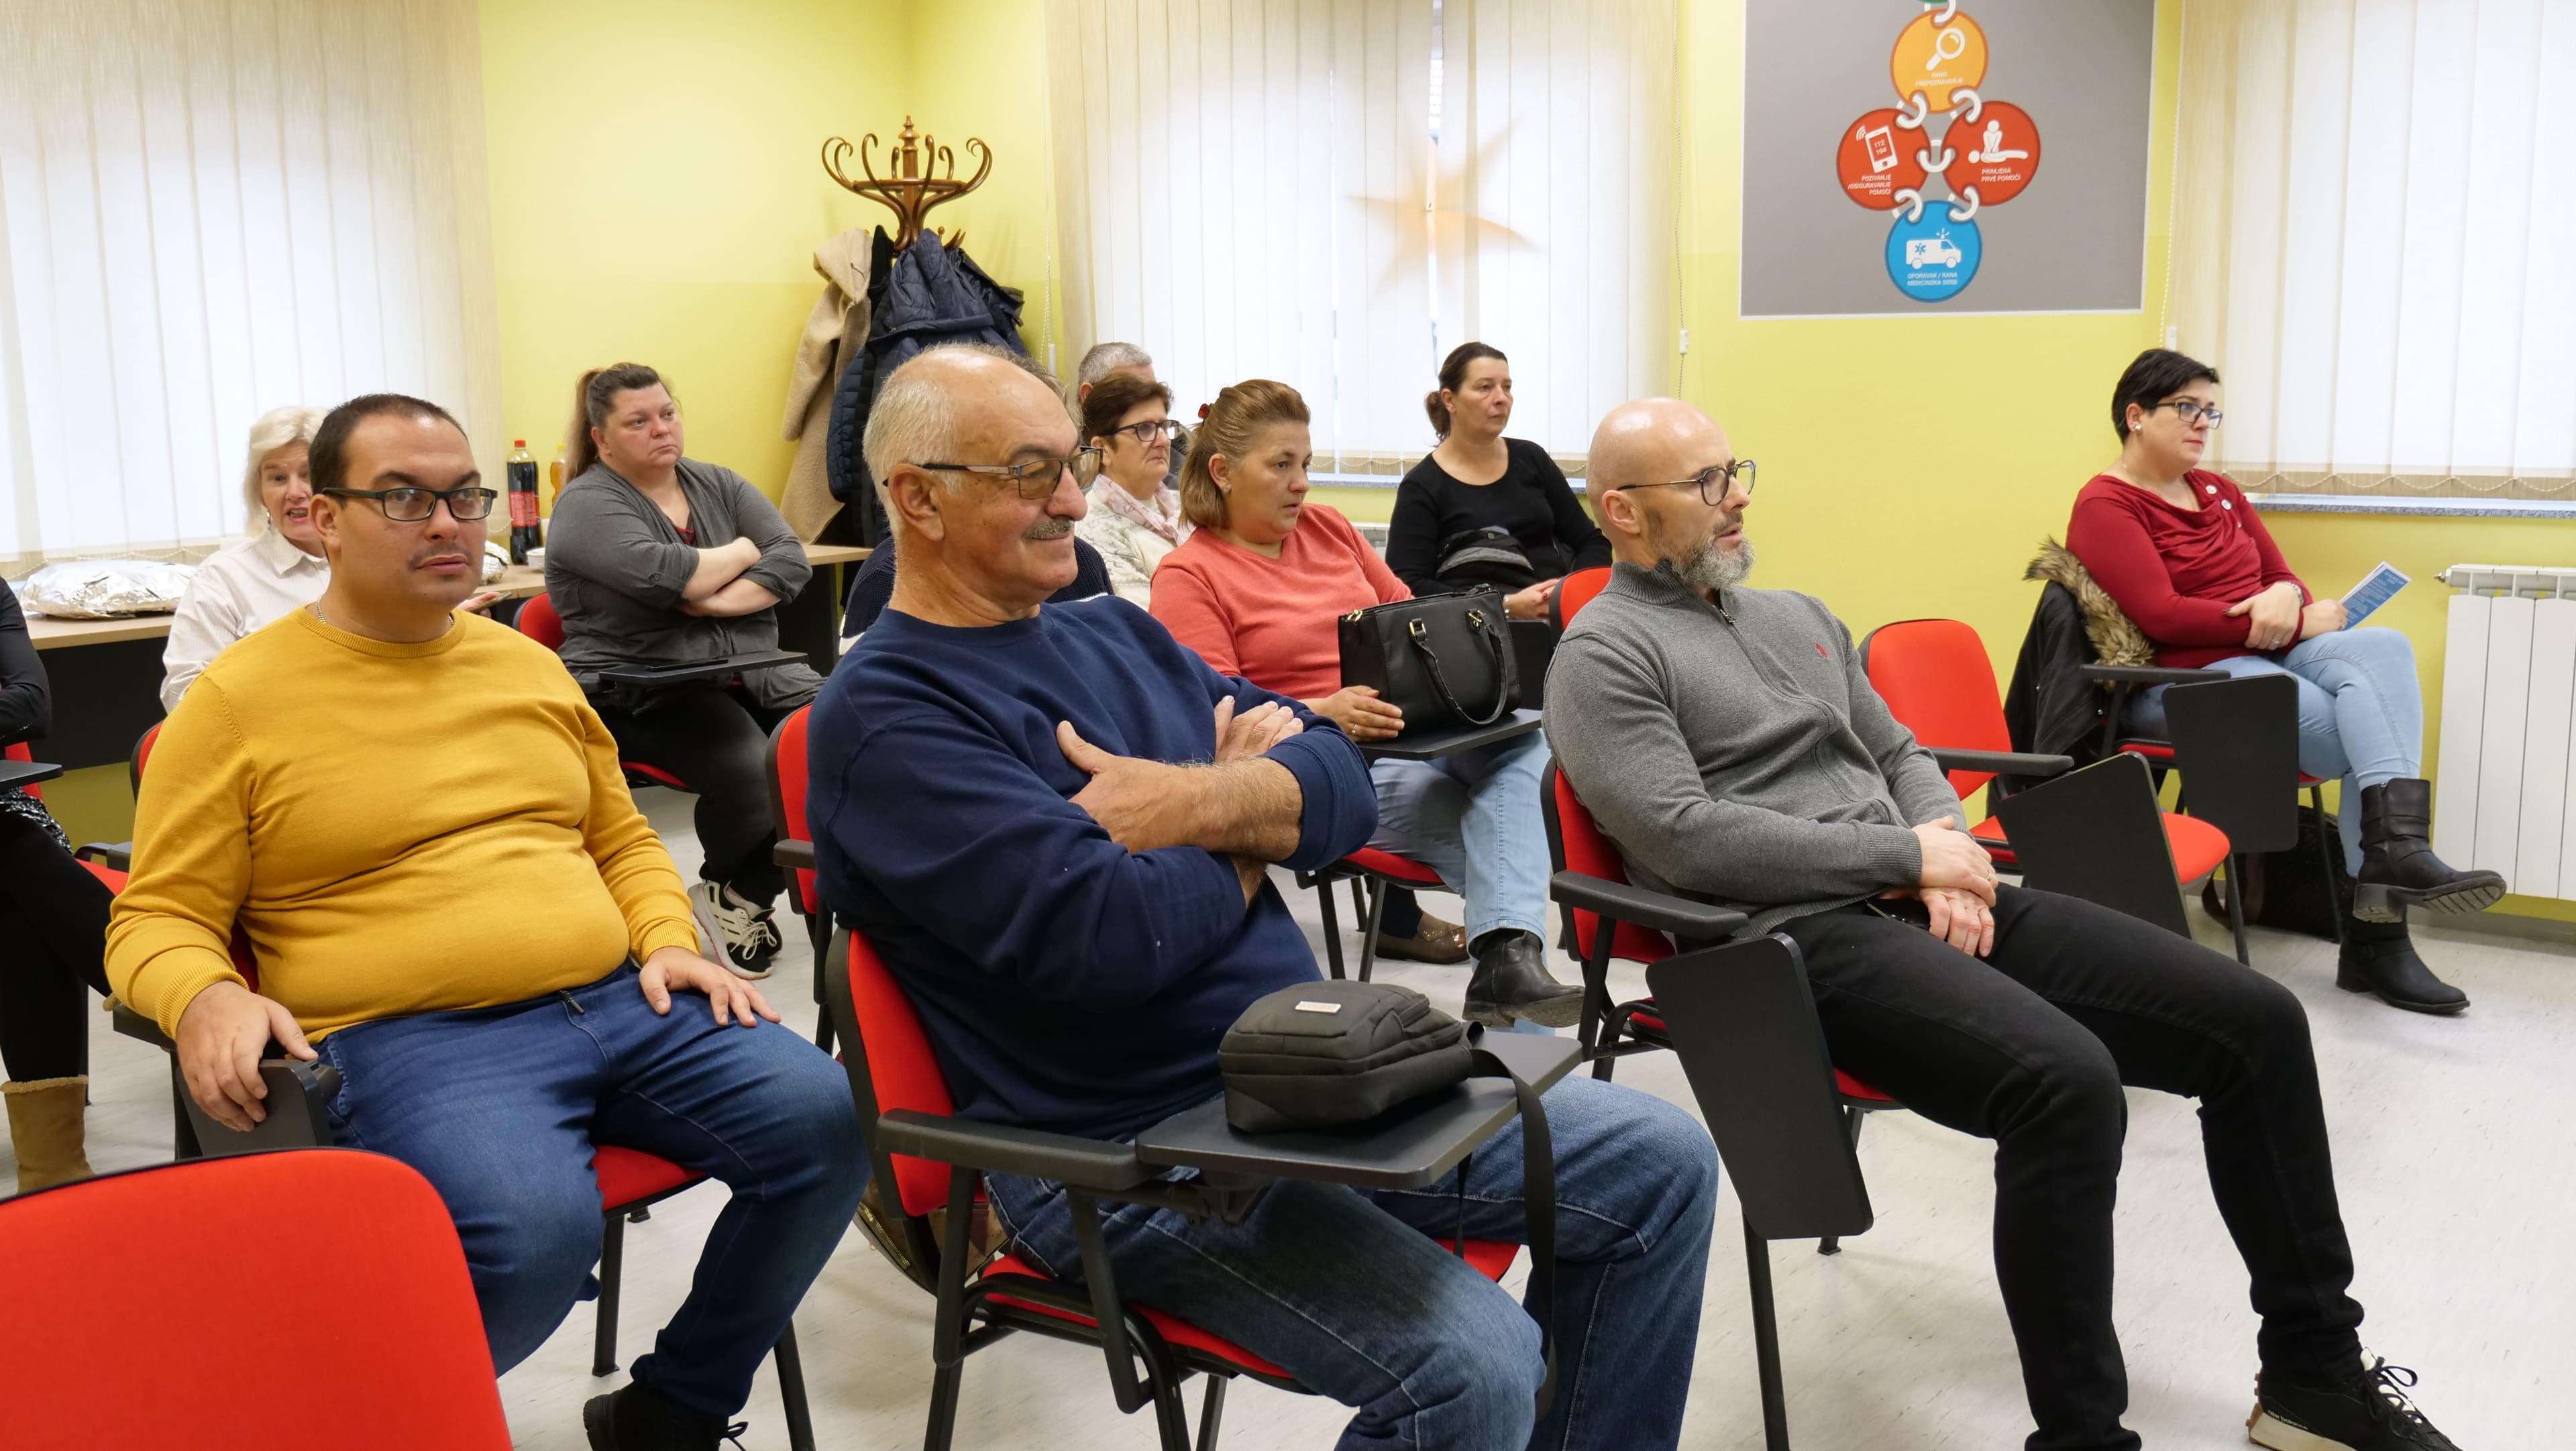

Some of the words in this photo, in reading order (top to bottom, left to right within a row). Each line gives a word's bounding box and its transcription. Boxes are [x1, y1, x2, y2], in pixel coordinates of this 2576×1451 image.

[1874, 140, 1885, 148] 112
[1982, 167, 2011, 175] PRIMJENA
[1997, 173, 2021, 182] POMOĆI
[2267, 1409, 2279, 1419] new
